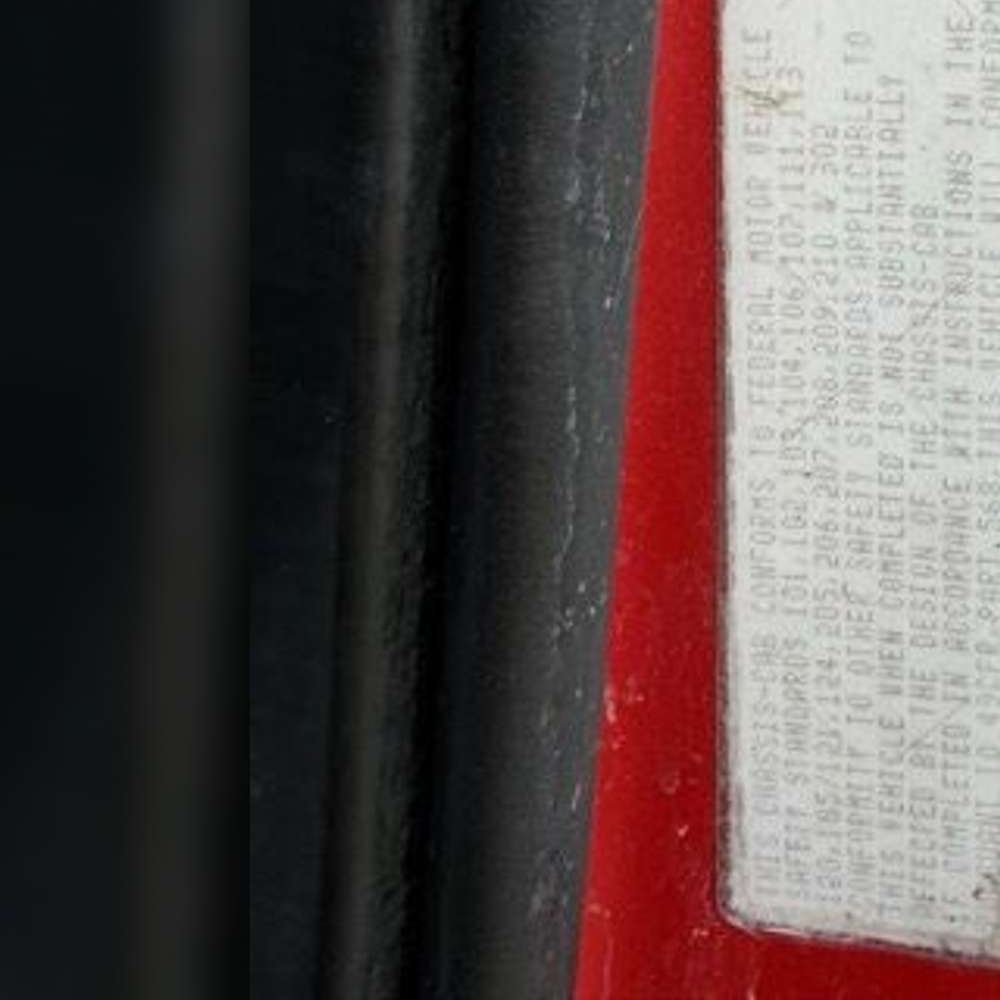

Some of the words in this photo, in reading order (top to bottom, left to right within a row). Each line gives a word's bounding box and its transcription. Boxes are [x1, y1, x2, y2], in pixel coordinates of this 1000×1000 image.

[843, 31, 871, 66] TO
[945, 15, 975, 71] THE
[741, 25, 772, 152] VEHICLE
[945, 93, 973, 128] IN
[811, 123, 839, 177] 302
[844, 86, 873, 270] APPLICABLE
[877, 74, 906, 306] SUBSTANTIALLY
[744, 175, 773, 264] MOTOR
[944, 149, 975, 368] INSTRUCTIONS
[747, 287, 775, 401] FEDERAL
[845, 291, 874, 448] STANDARDS
[878, 330, 904, 379] NOT
[878, 400, 904, 432] IS
[909, 420, 937, 472] THE
[943, 387, 973, 459] WITH
[749, 478, 777, 614] CONFORMS
[846, 470, 874, 571] SAFETY
[878, 451, 905, 610] COMPLETED
[909, 493, 936, 526] OF
[909, 545, 937, 649] DESIGN
[942, 477, 973, 650] ACCORDANCE
[878, 629, 905, 697] WHEN
[910, 667, 937, 718] THE
[942, 672, 970, 706] IN
[781, 636, 810, 786] STANDARDS
[847, 697, 875, 726] TO
[877, 715, 905, 831] VEHICLE
[941, 723, 971, 874] COMPLETED
[878, 848, 904, 916] THIS
